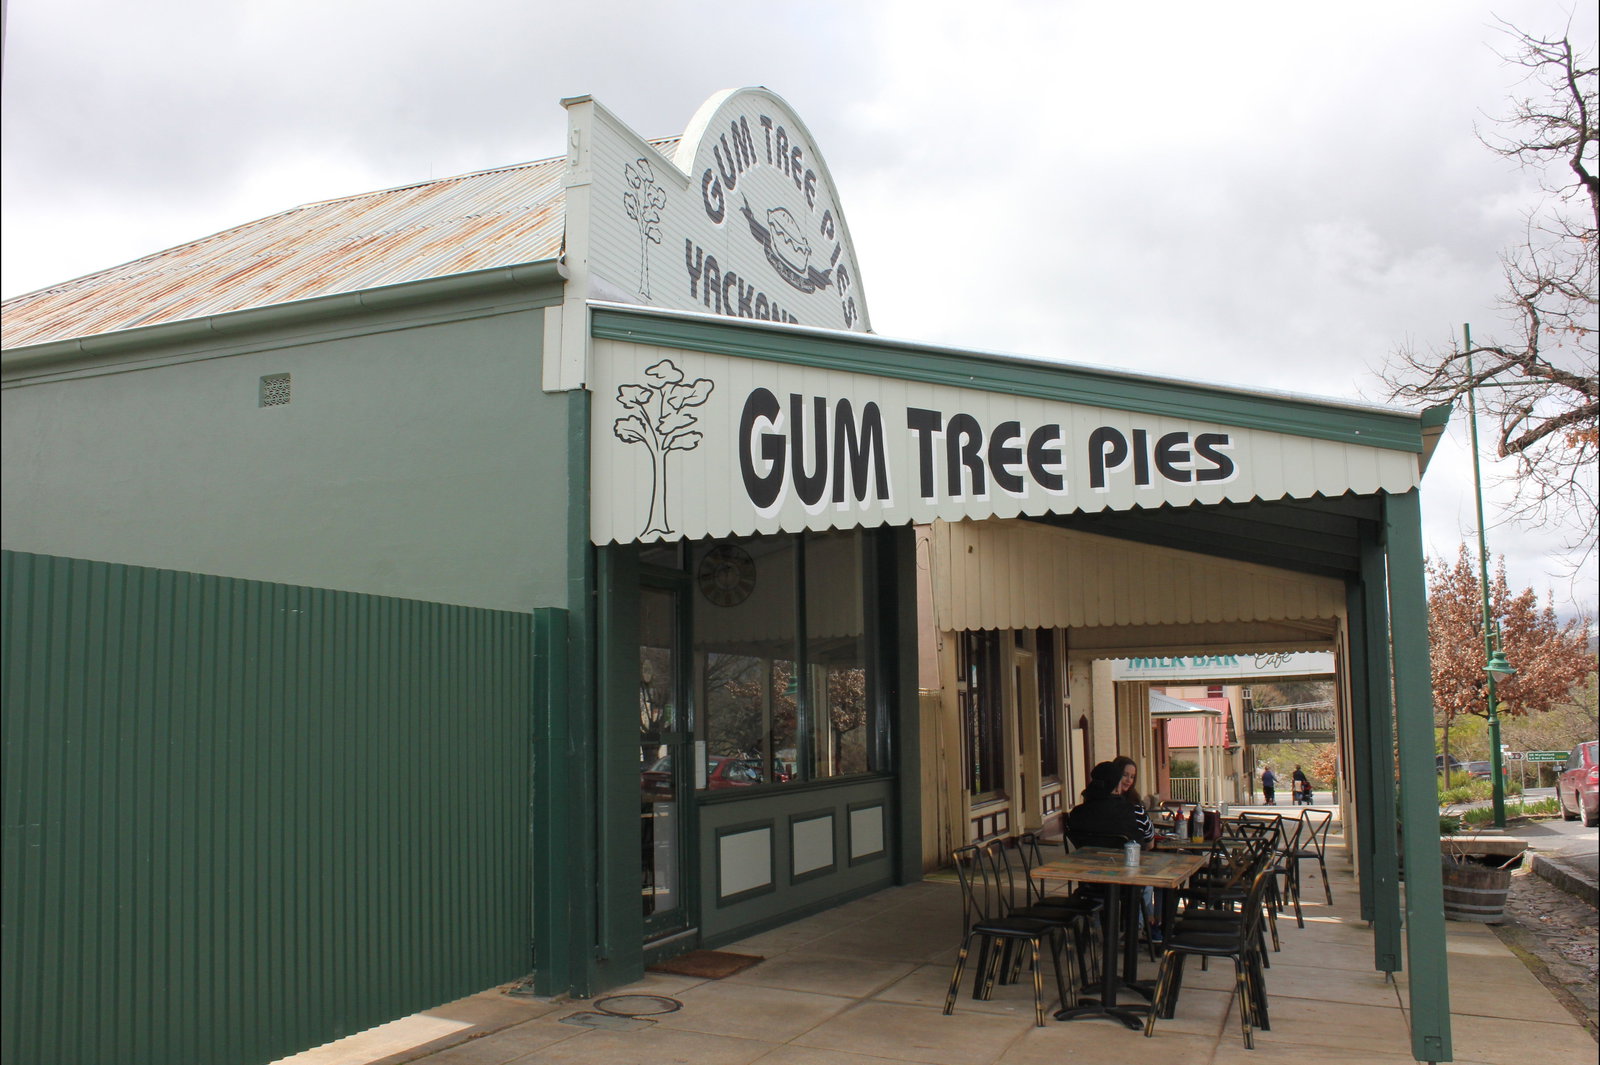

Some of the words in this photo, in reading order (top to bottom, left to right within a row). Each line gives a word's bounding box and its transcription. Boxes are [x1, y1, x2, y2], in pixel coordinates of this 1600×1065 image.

[701, 115, 757, 225] GUM
[760, 114, 817, 213] TREE
[820, 209, 858, 330] PIES
[739, 387, 891, 510] GUM
[907, 407, 1065, 499] TREE
[1089, 426, 1236, 489] PIES
